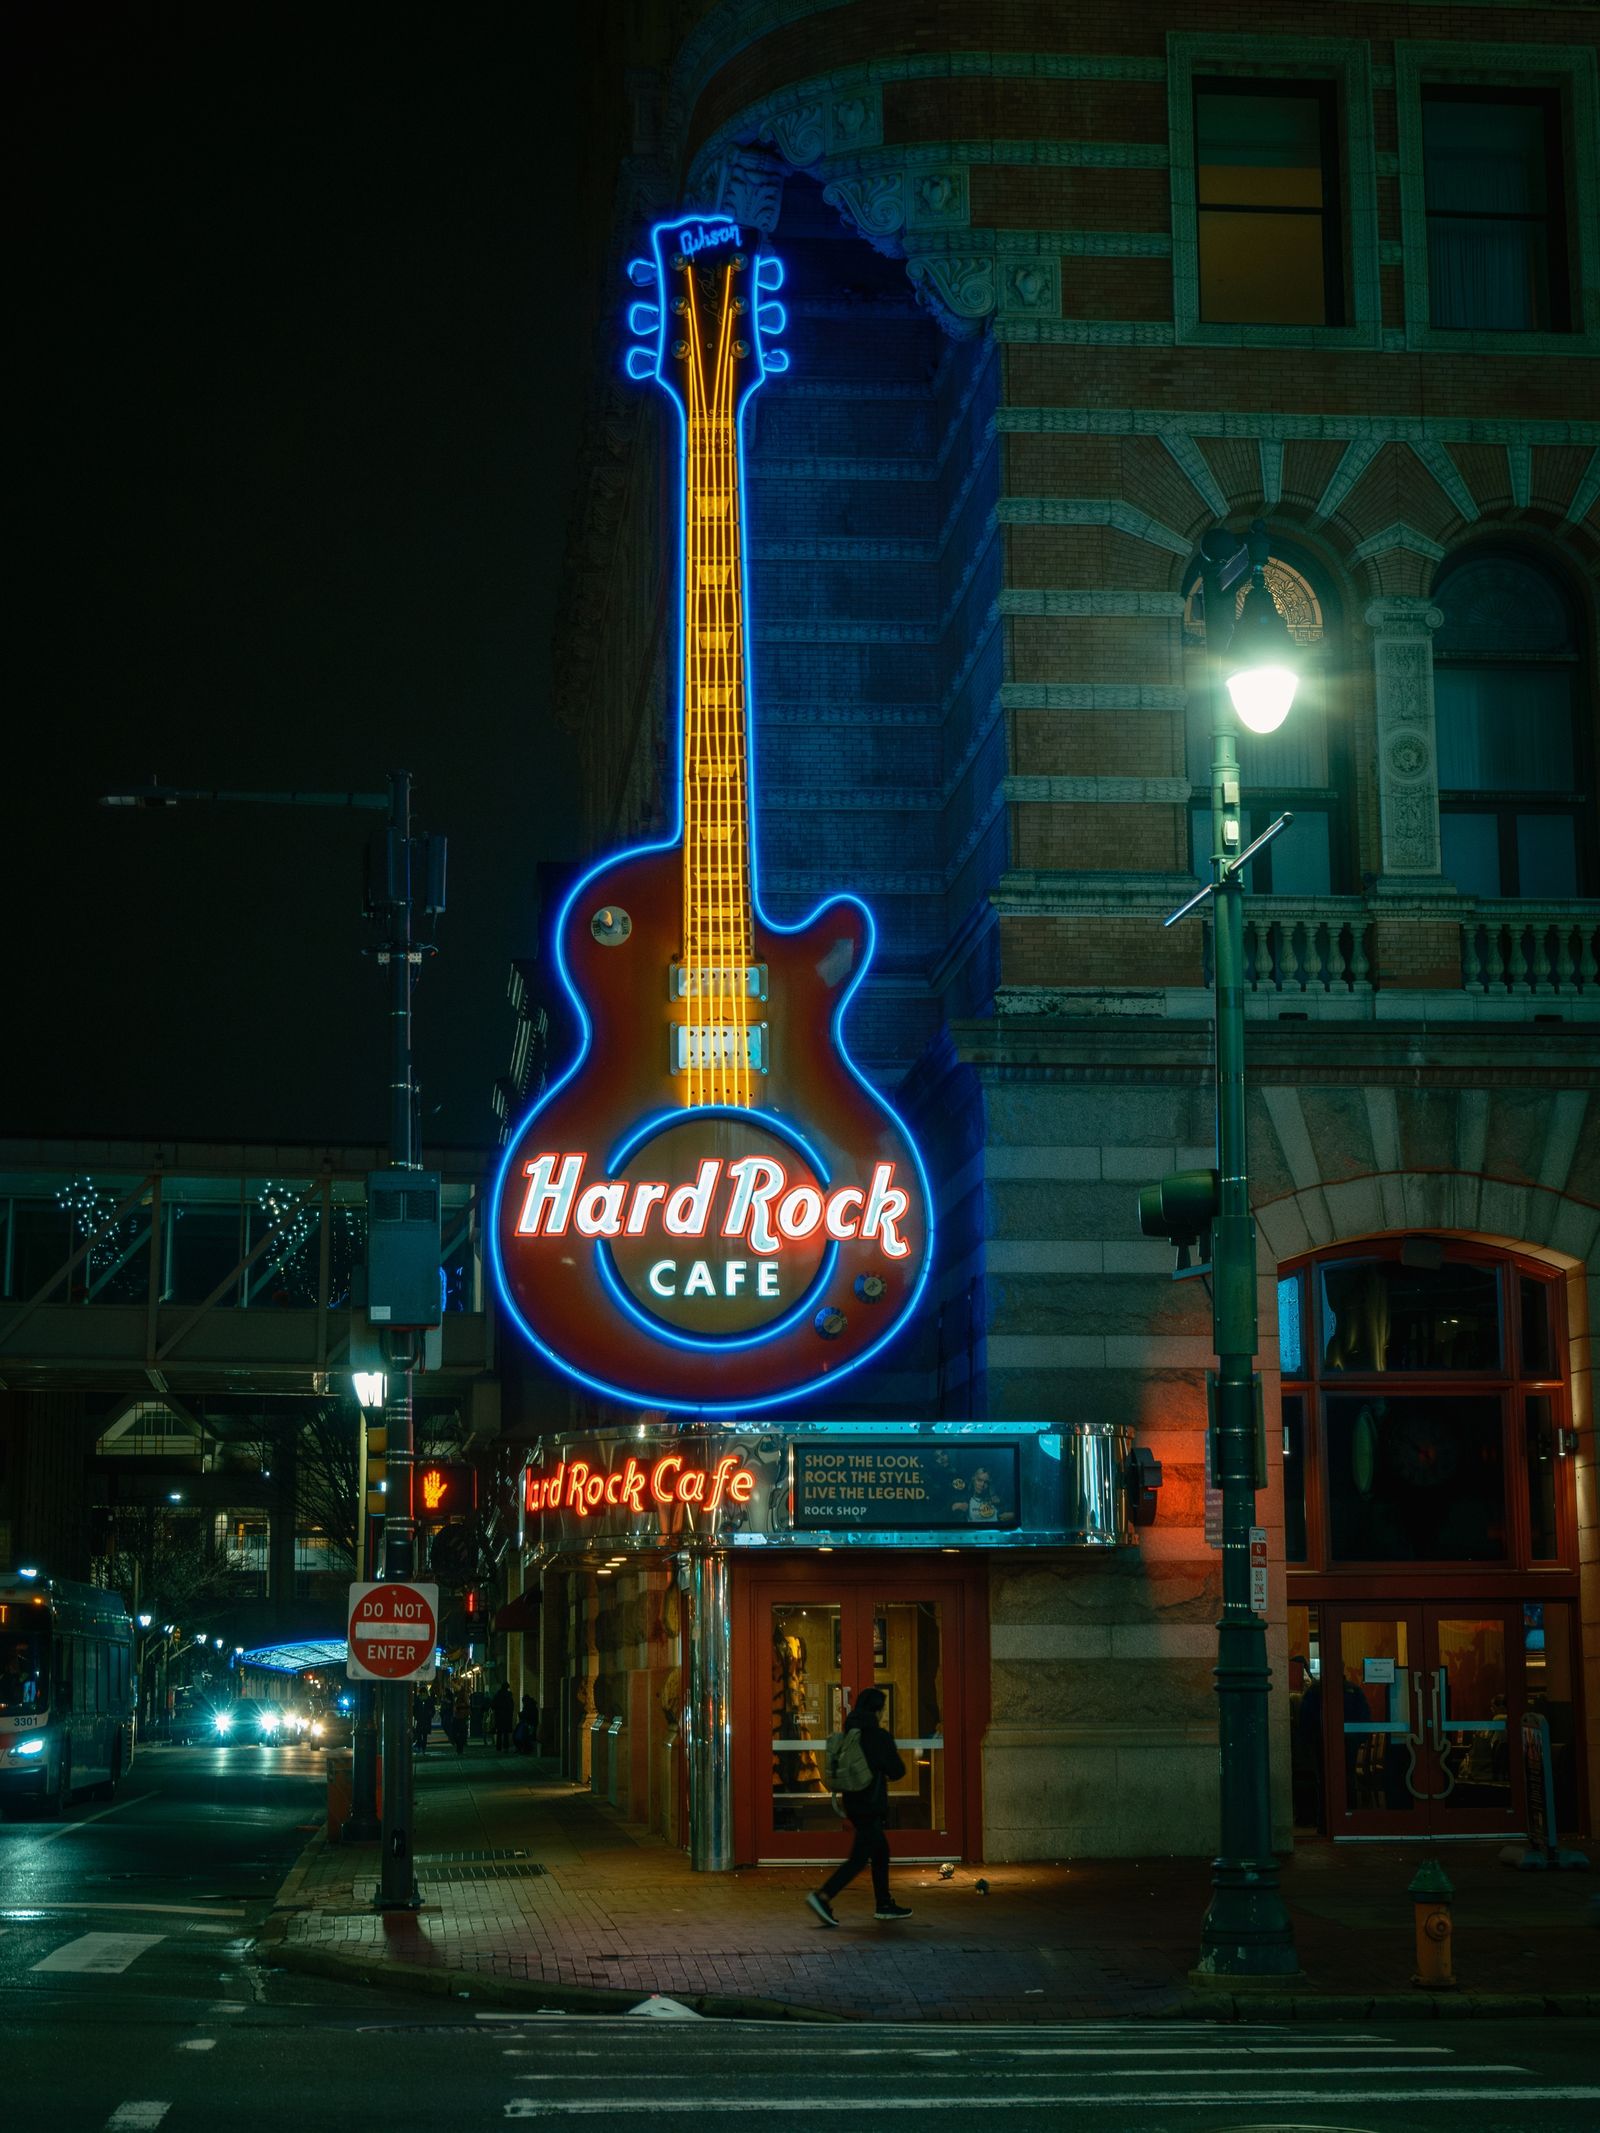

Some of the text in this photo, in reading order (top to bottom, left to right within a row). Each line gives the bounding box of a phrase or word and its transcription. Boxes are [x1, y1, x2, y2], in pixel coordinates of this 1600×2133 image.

[514, 1152, 911, 1260] Hard Rock
[648, 1259, 780, 1297] CAFE
[804, 1455, 924, 1468] SHOP THE LOOK.
[804, 1471, 924, 1484] ROCK THE STYLE.
[565, 1456, 646, 1517] Rock
[651, 1455, 755, 1513] Cafe
[804, 1487, 930, 1500] LIVE THE LEGEND.
[804, 1506, 867, 1516] ROCK SHOP
[363, 1603, 424, 1618] DO NOT
[367, 1645, 416, 1660] ENTER
[14, 1716, 39, 1727] 3301
